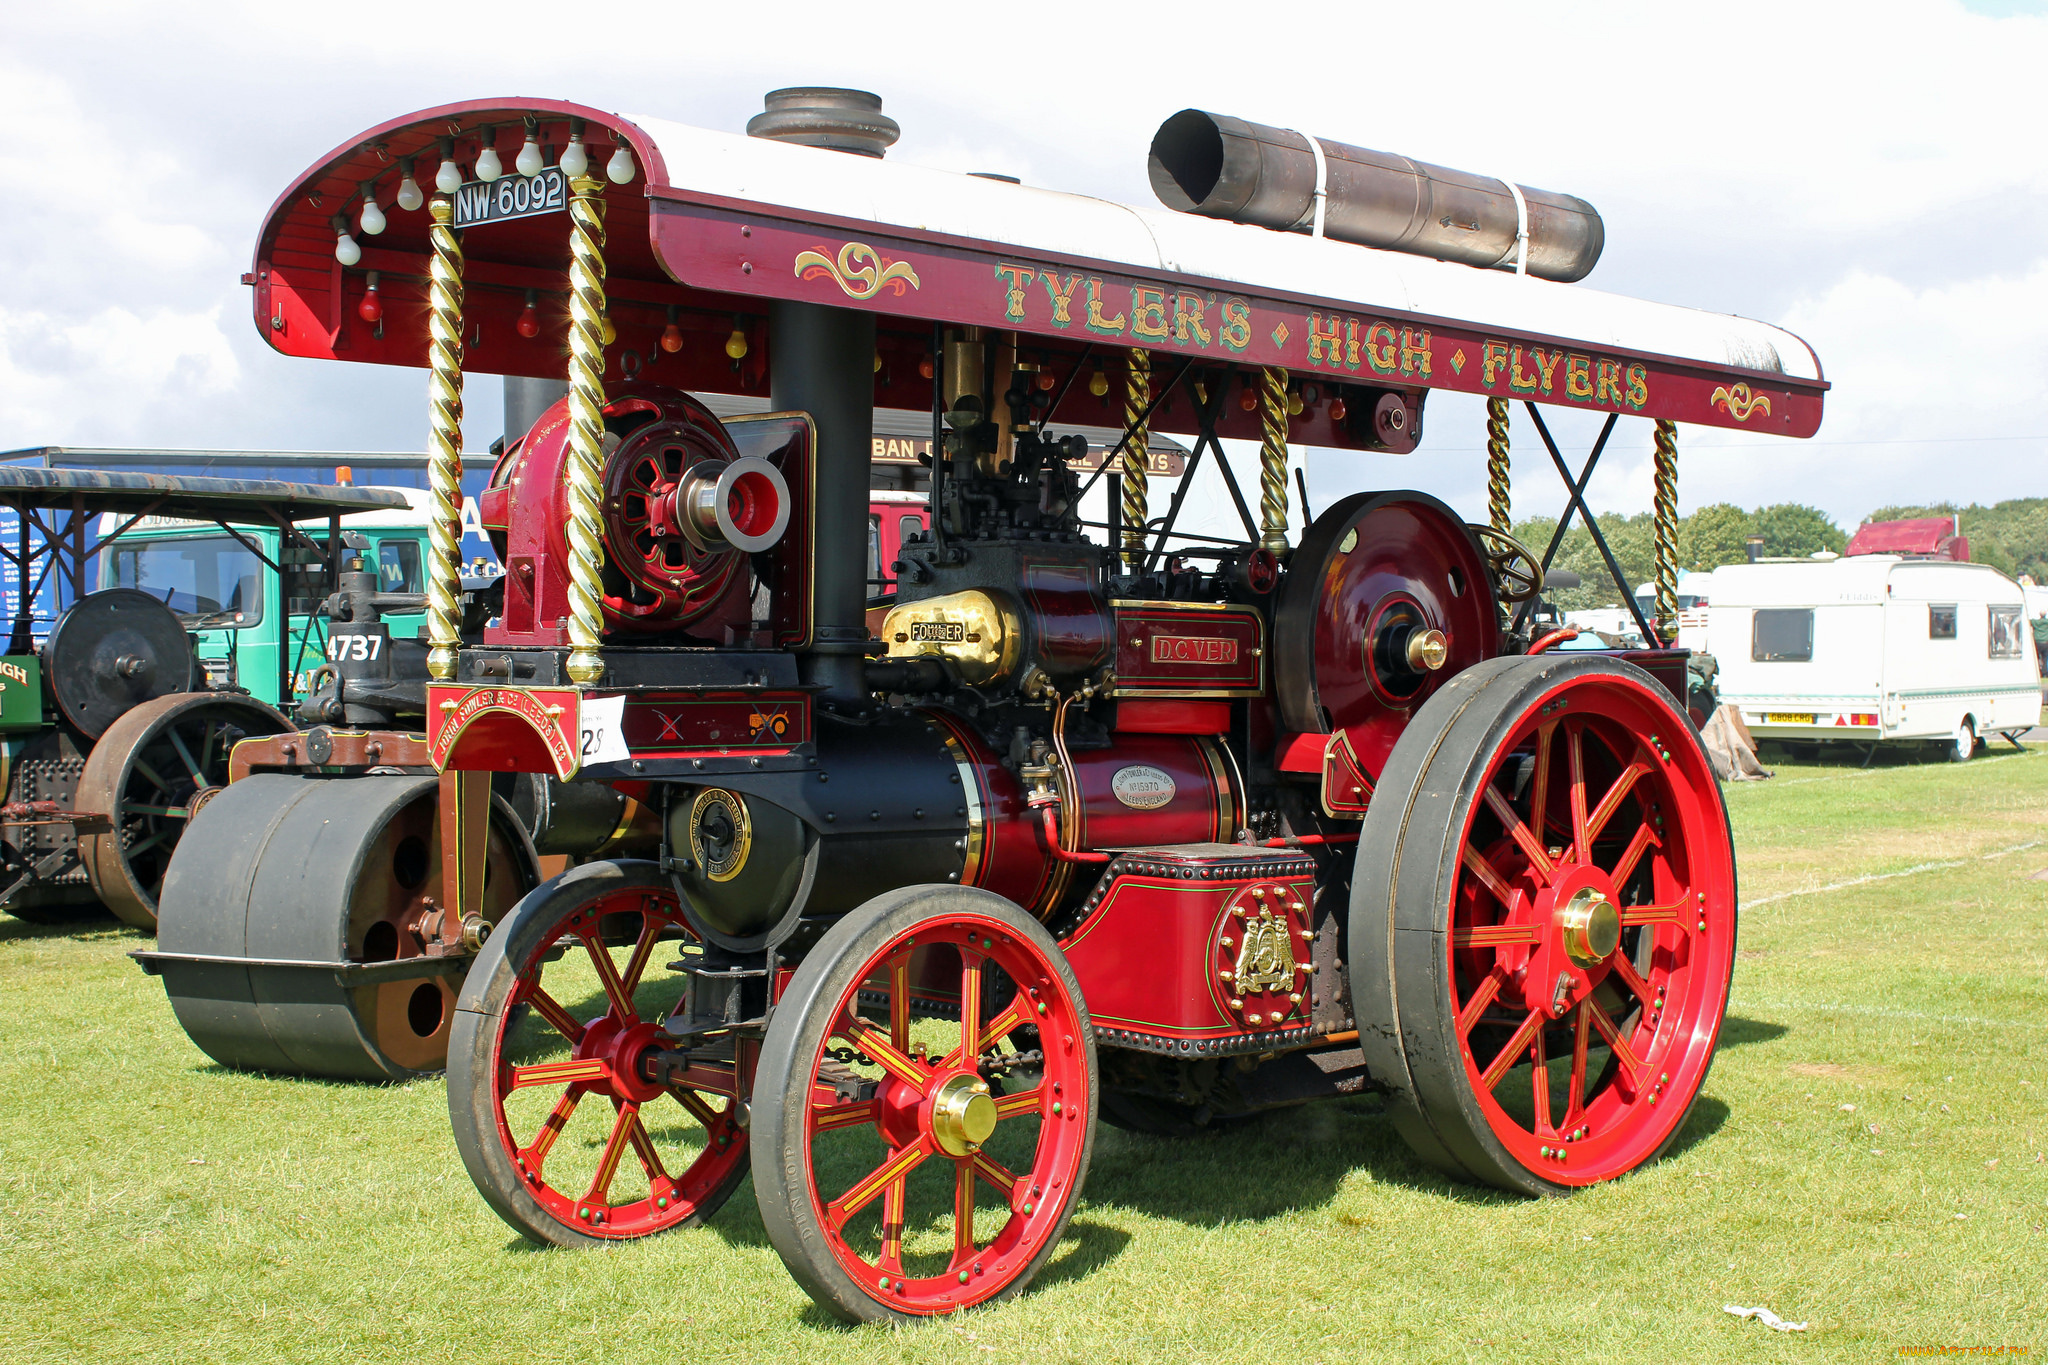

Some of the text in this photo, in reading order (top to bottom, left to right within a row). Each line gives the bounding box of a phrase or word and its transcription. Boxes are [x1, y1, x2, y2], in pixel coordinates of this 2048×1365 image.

[995, 262, 1648, 410] TYLER'S HIGH FLYERS
[1102, 451, 1168, 470] DEYS
[327, 635, 382, 661] 4737
[440, 718, 459, 755] JOHN
[459, 691, 494, 722] FOWLER
[497, 691, 505, 704] &
[520, 696, 557, 742] (LEEDS)
[1061, 963, 1095, 1047] DUNLOP
[785, 1146, 814, 1242] DUNLOP
